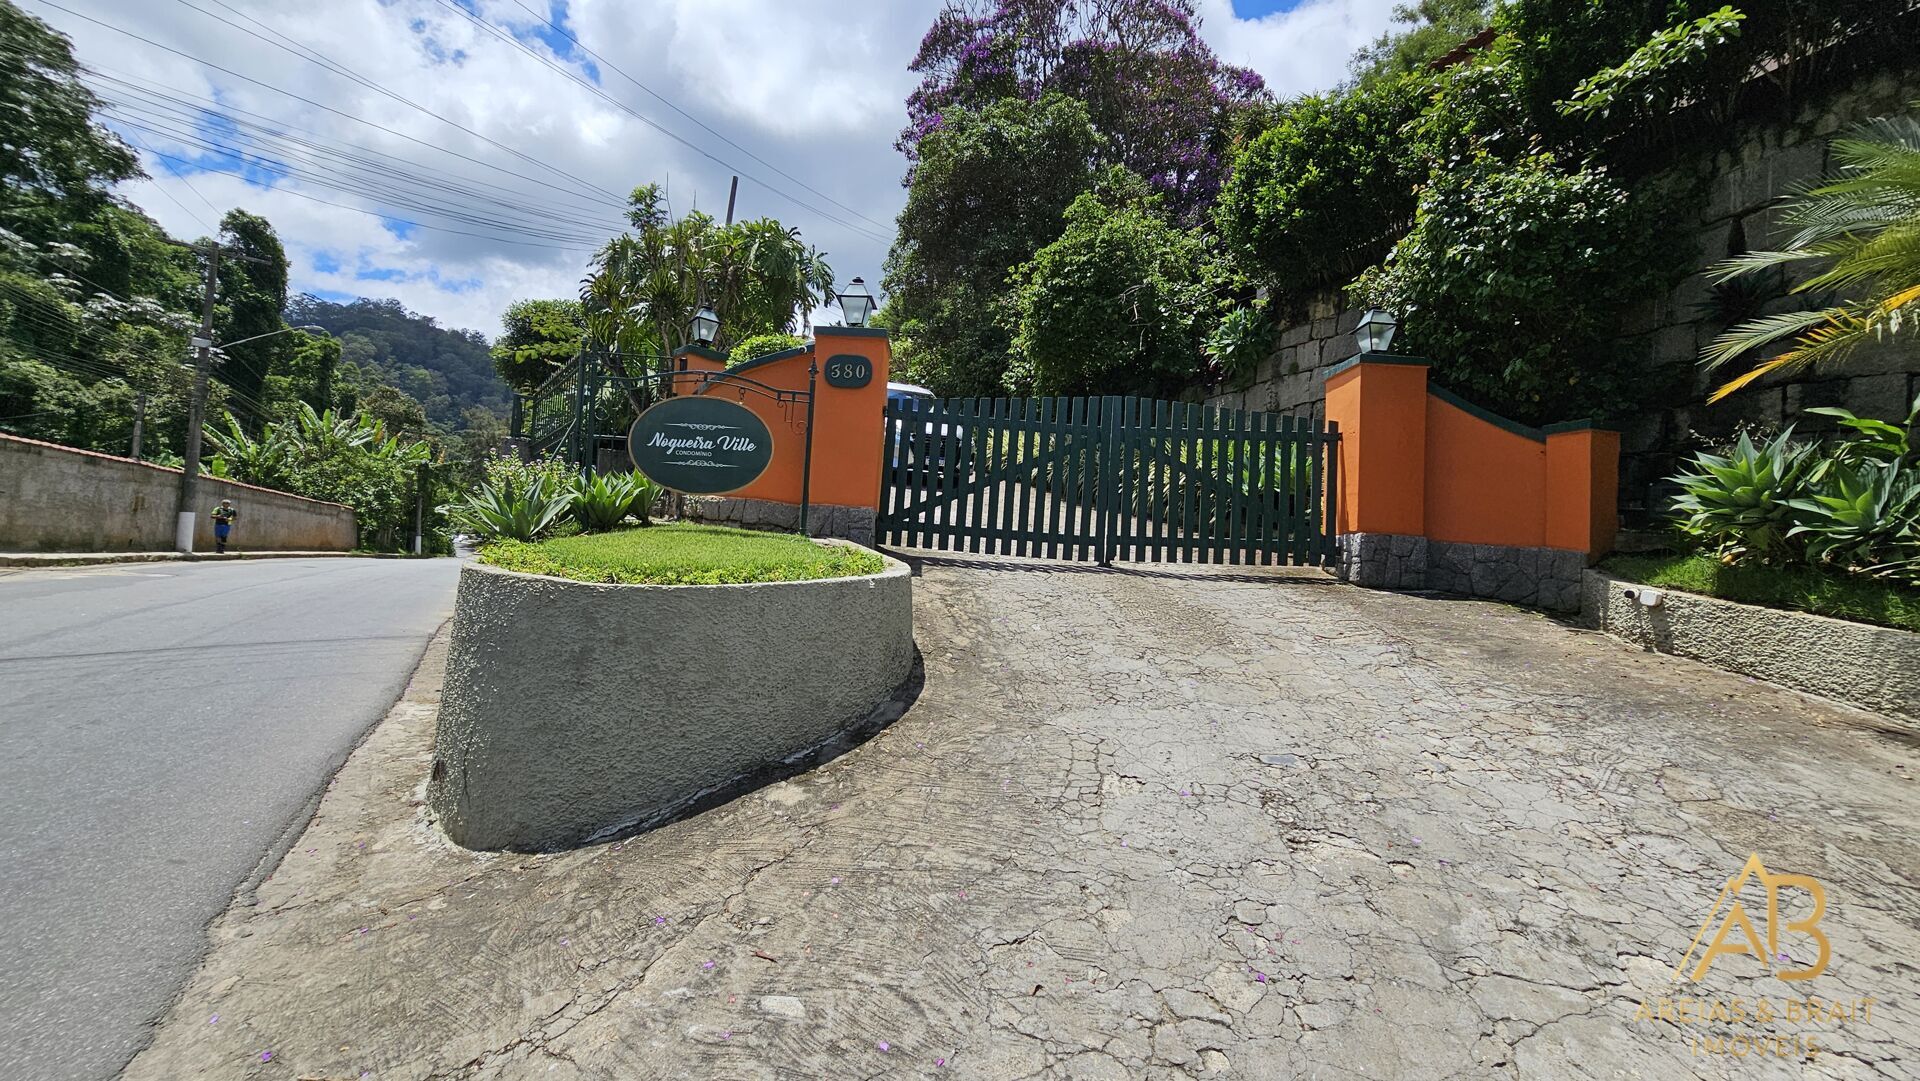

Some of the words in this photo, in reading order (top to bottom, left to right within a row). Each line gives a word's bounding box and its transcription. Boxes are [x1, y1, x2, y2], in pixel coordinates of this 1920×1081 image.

[831, 363, 865, 379] 380
[646, 431, 716, 455] Nogueira
[716, 435, 757, 452] Ville
